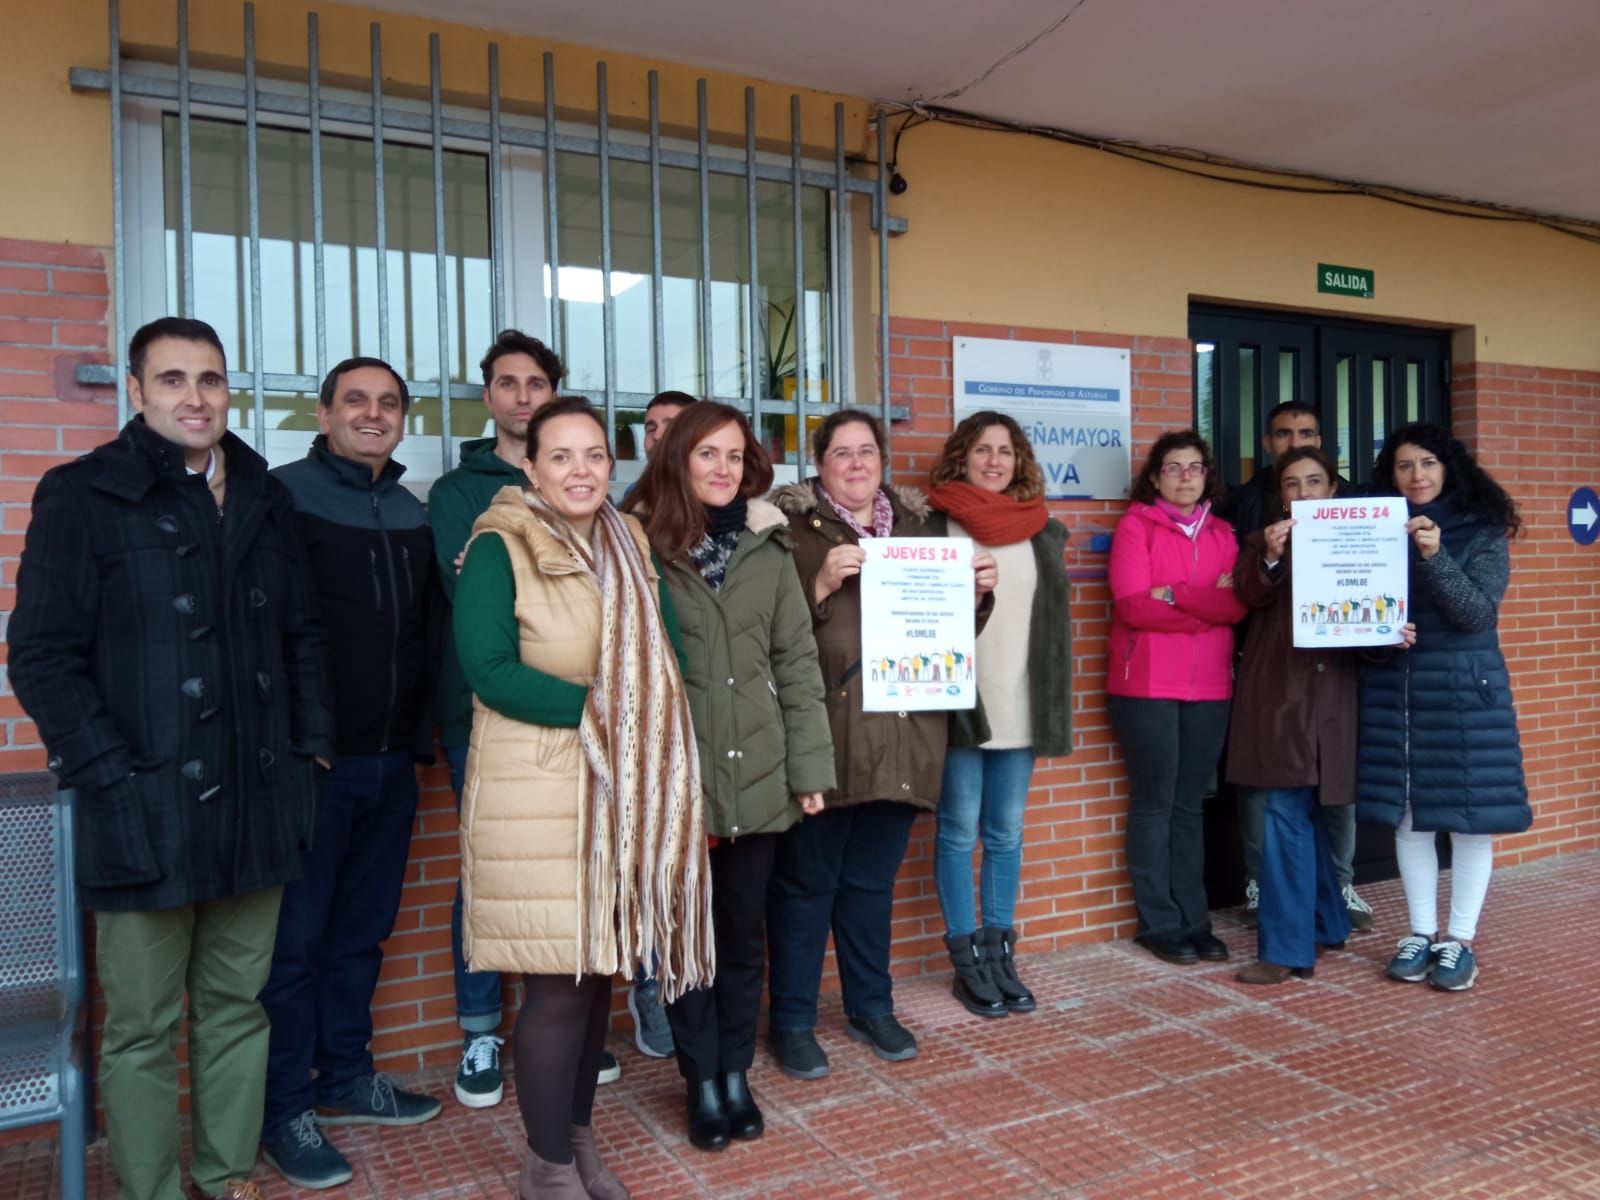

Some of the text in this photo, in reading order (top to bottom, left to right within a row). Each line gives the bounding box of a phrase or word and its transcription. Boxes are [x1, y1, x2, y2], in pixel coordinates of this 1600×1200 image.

[1325, 271, 1368, 291] SALIDA
[1312, 506, 1390, 520] JUEVES 24
[883, 546, 958, 560] JUEVES 24
